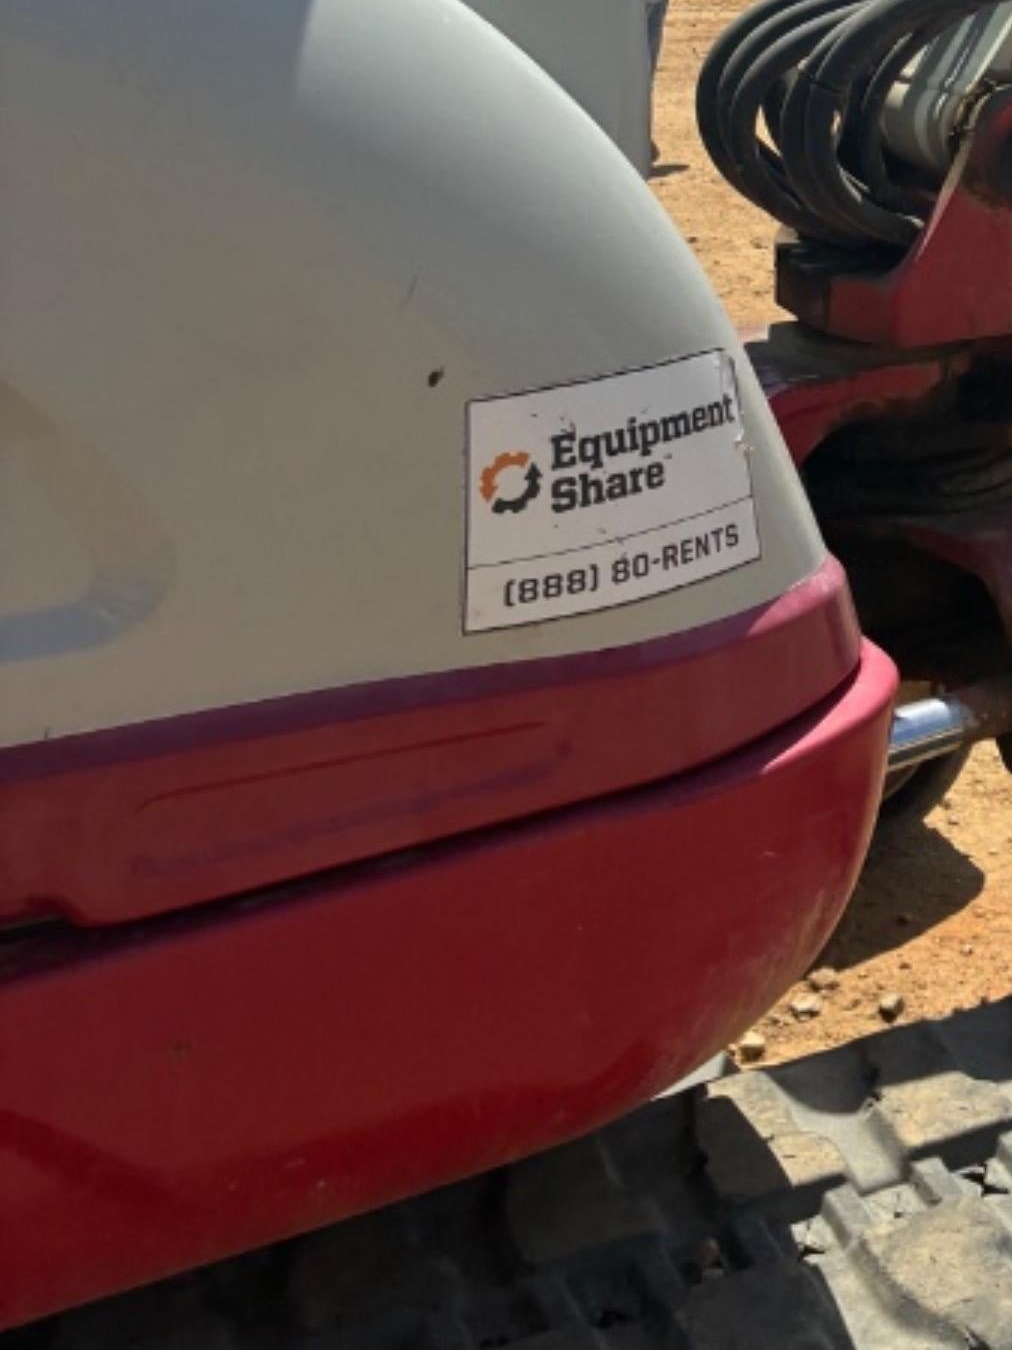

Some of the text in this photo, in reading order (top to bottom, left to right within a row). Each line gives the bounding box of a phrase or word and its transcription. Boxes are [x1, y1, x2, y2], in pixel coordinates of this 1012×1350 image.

[550, 394, 735, 470] Equipment
[551, 461, 664, 513] Share
[503, 524, 739, 607] (888) 80-RENTS
